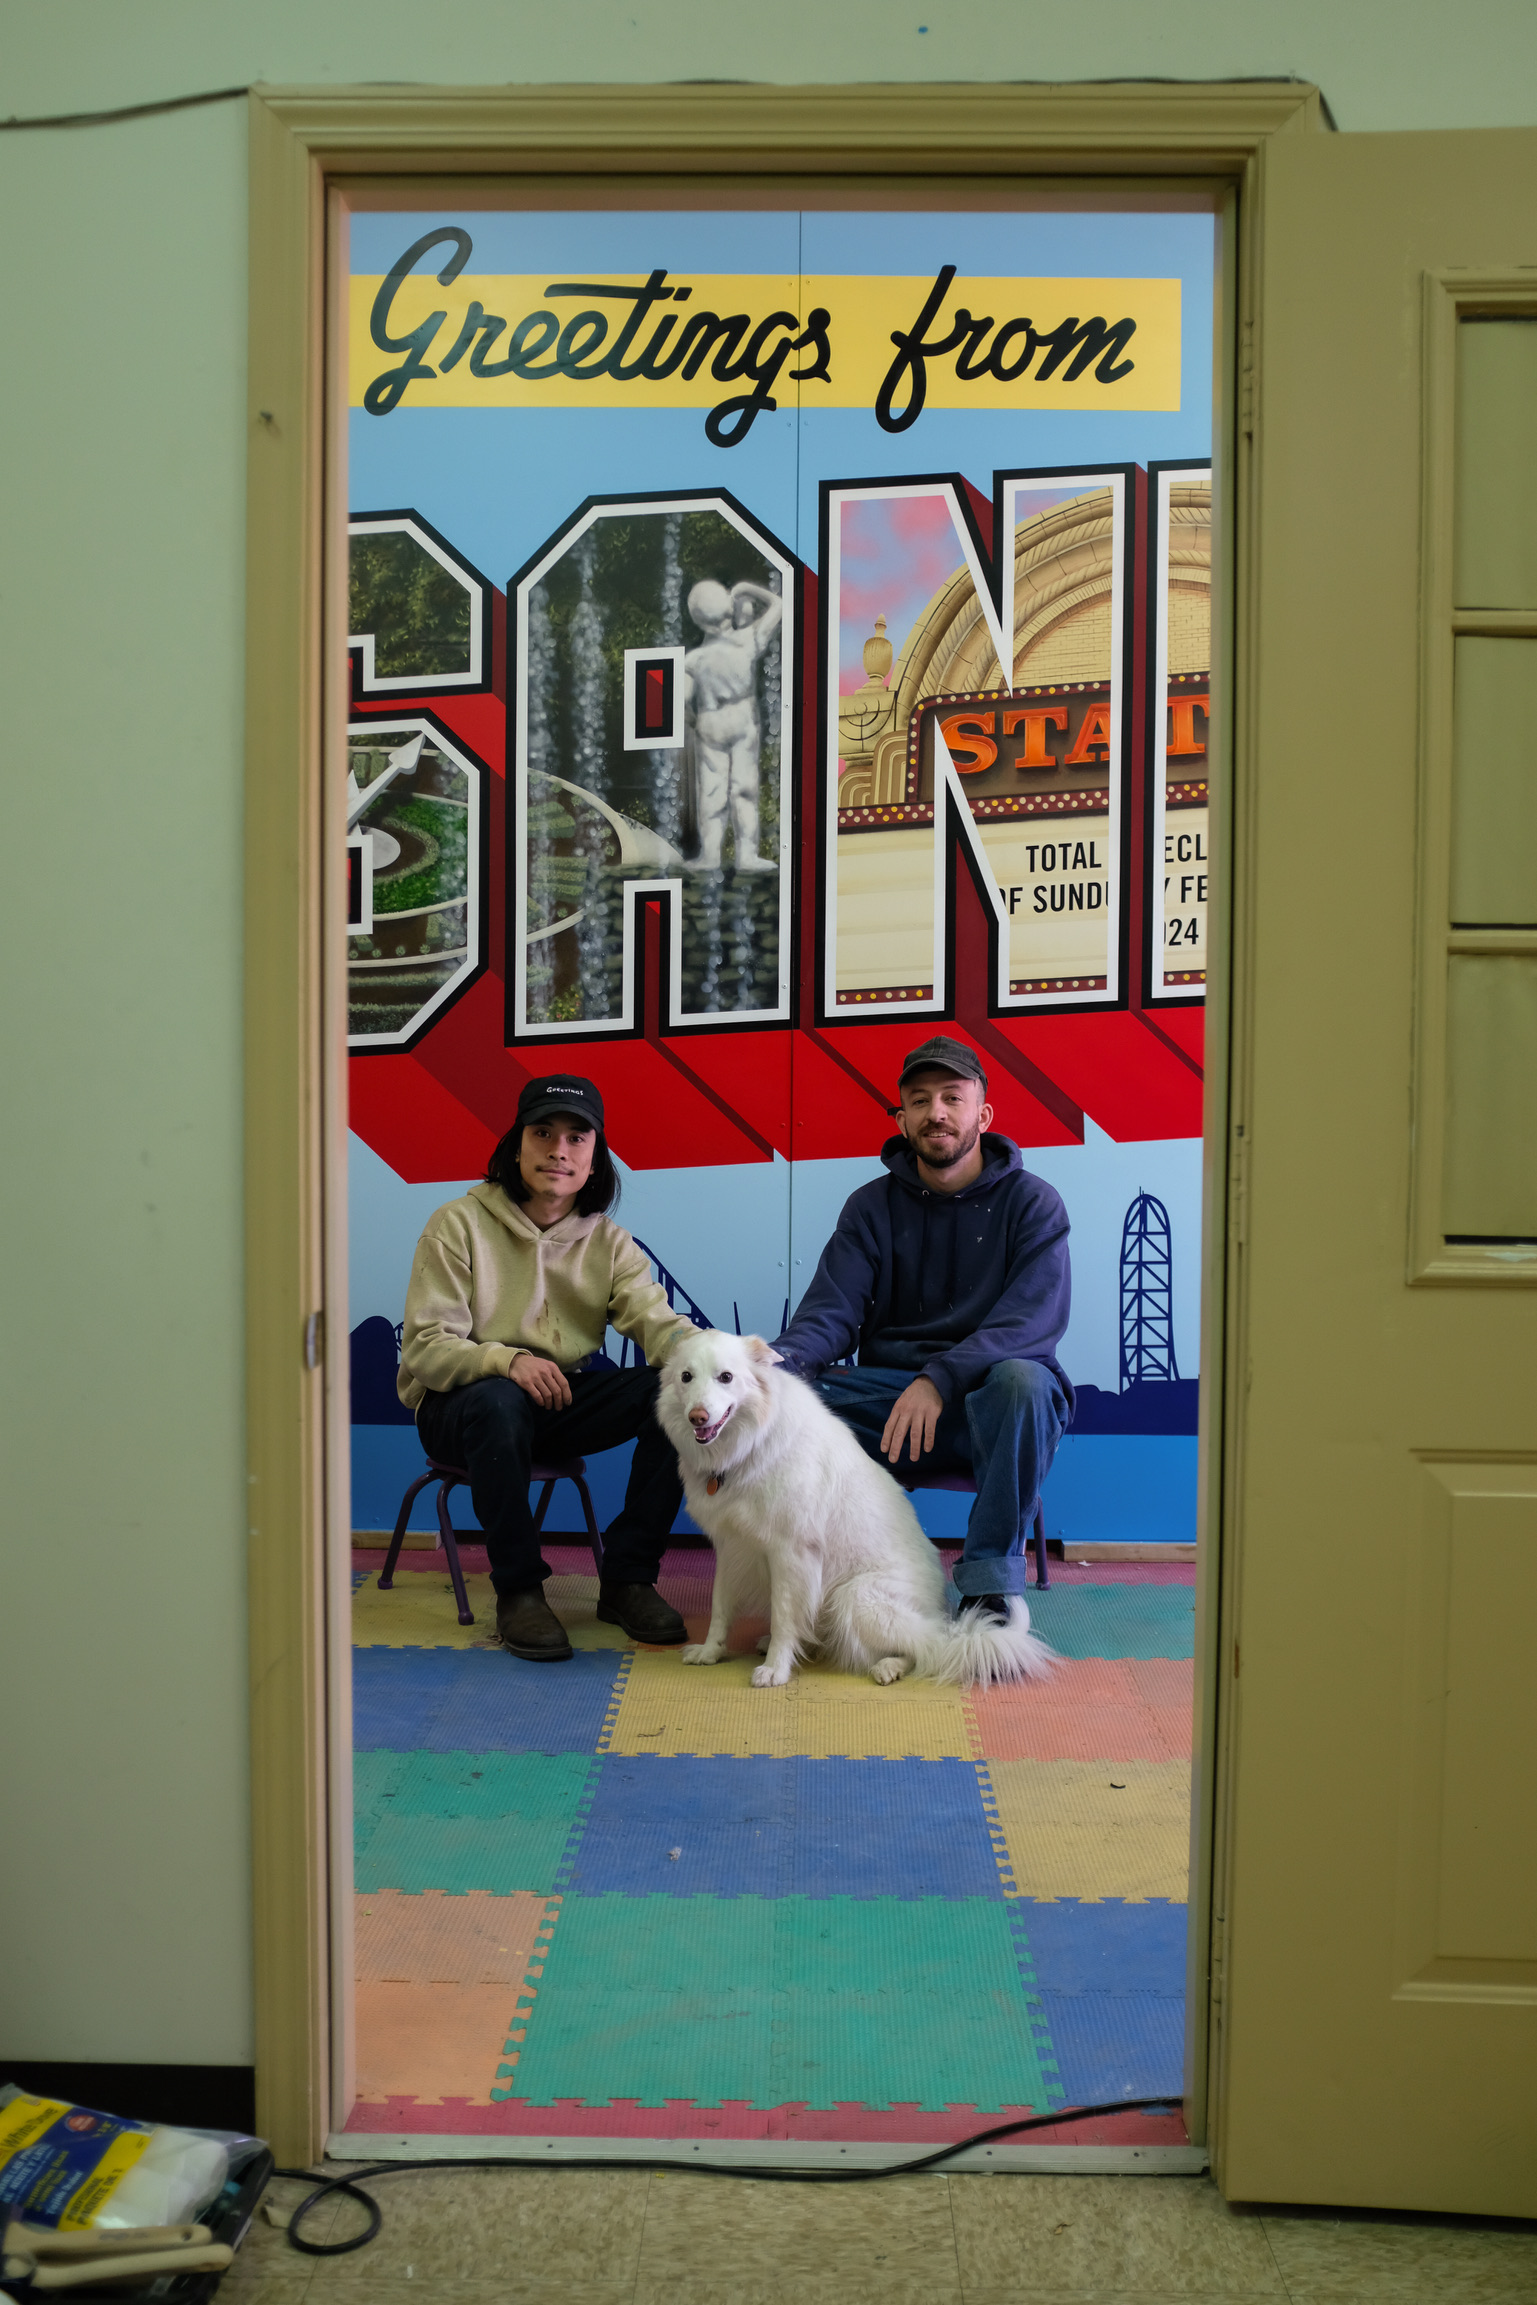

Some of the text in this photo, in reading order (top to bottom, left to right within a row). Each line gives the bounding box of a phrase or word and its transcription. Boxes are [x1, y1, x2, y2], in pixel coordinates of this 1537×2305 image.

[363, 225, 1135, 447] Greetings from
[1025, 841, 1102, 872] TOTAL
[1033, 881, 1108, 913] SUND
[1164, 918, 1199, 946] 24
